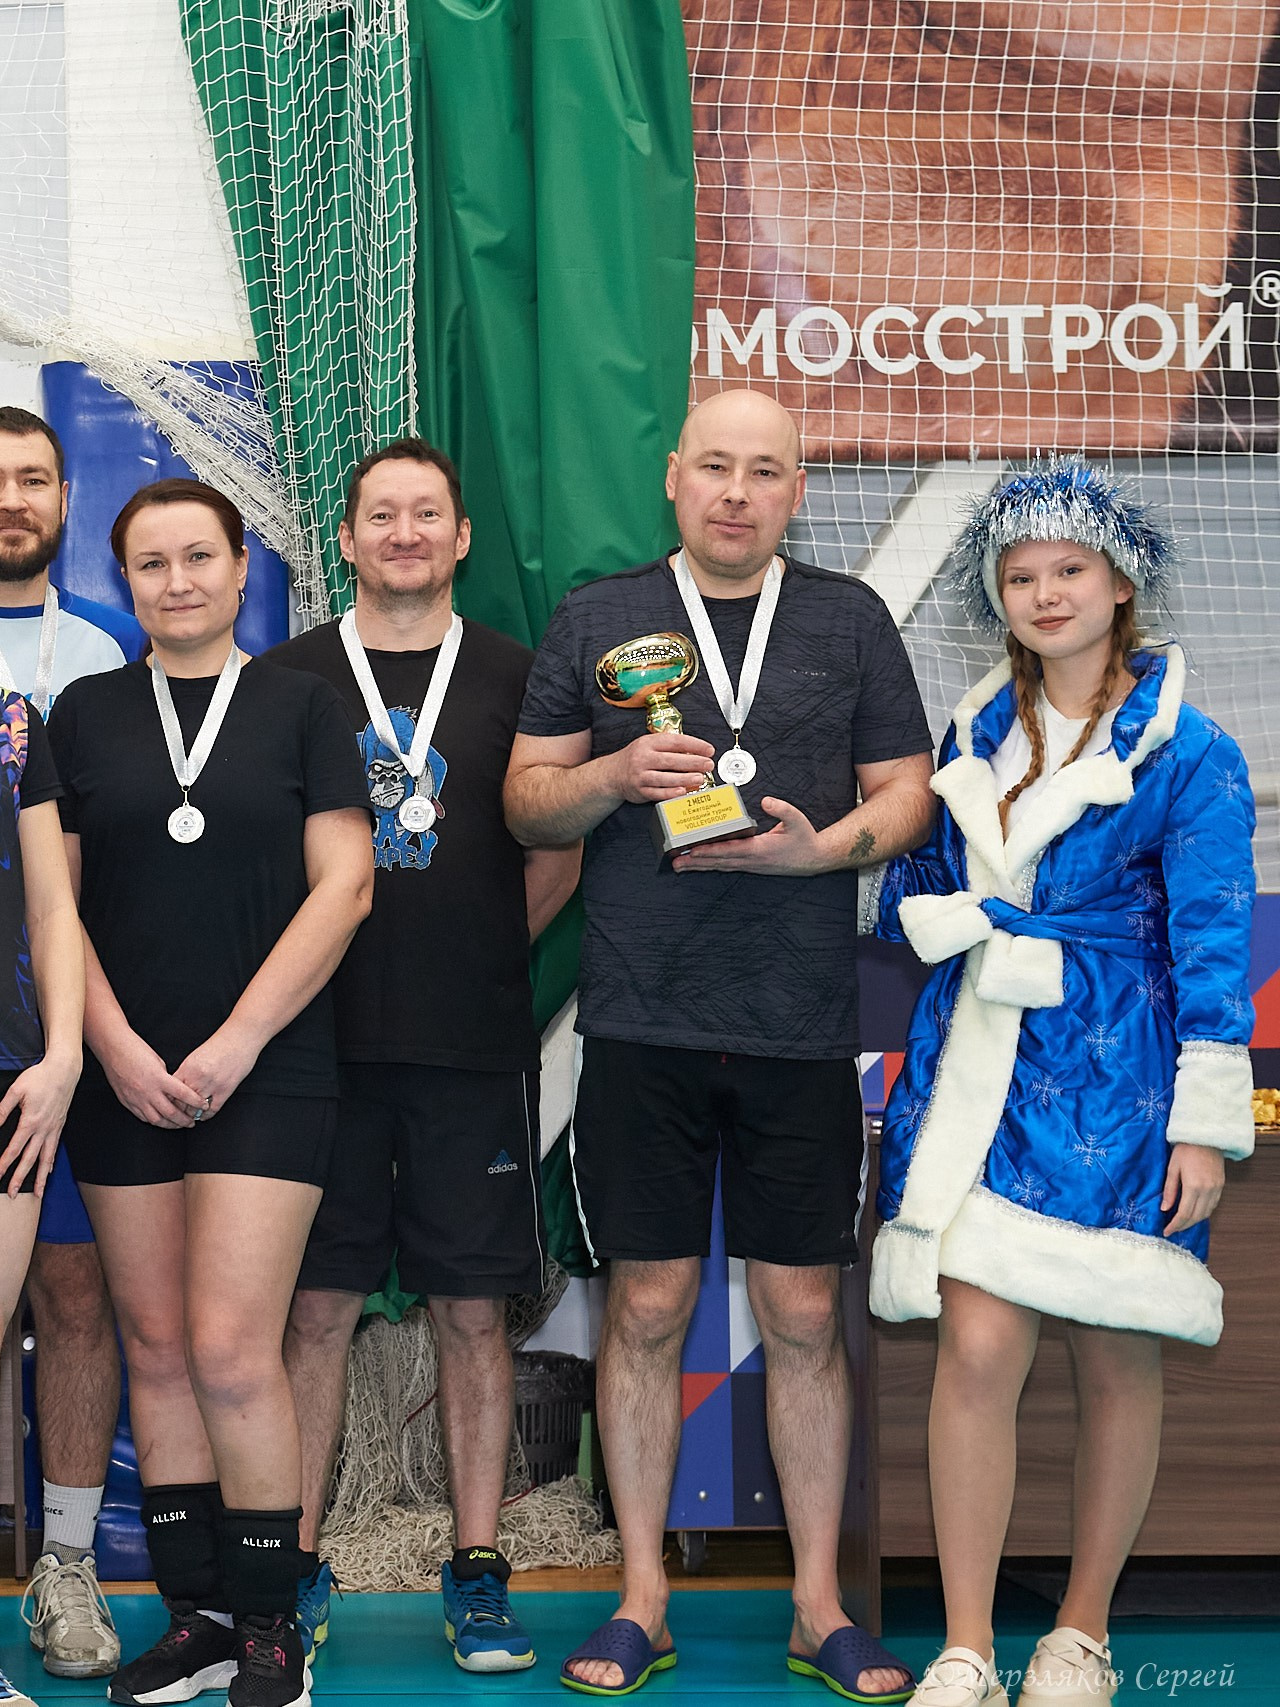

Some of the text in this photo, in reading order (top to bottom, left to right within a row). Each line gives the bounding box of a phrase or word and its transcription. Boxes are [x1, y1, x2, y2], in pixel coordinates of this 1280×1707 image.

[691, 282, 1245, 377] МОССТРОЙ
[693, 795, 712, 805] МЕСТО
[685, 813, 727, 829] VOLLEYGROUP
[488, 1162, 518, 1174] adidas
[153, 1511, 187, 1524] ALLSIX
[242, 1537, 281, 1548] ALLSIX
